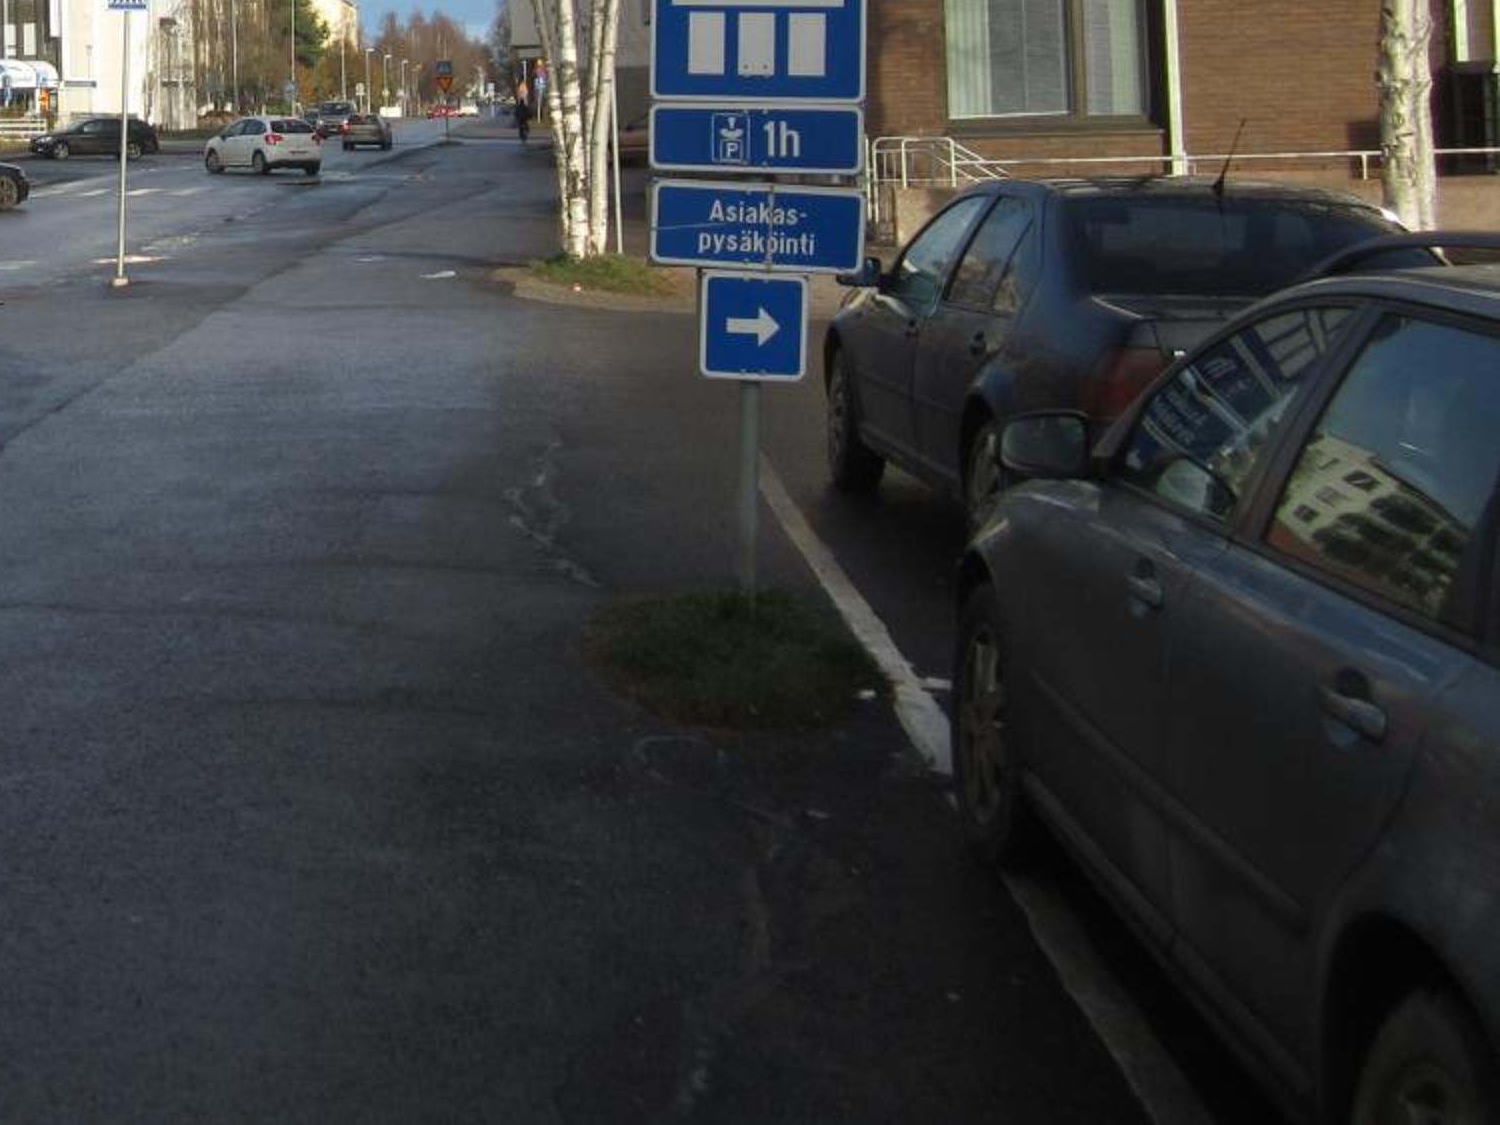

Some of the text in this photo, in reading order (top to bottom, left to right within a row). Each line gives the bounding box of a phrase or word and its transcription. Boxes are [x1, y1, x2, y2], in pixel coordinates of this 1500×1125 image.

[726, 121, 800, 157] P 1h
[708, 199, 807, 225] Asiakas-
[698, 230, 816, 256] pysäköinti
